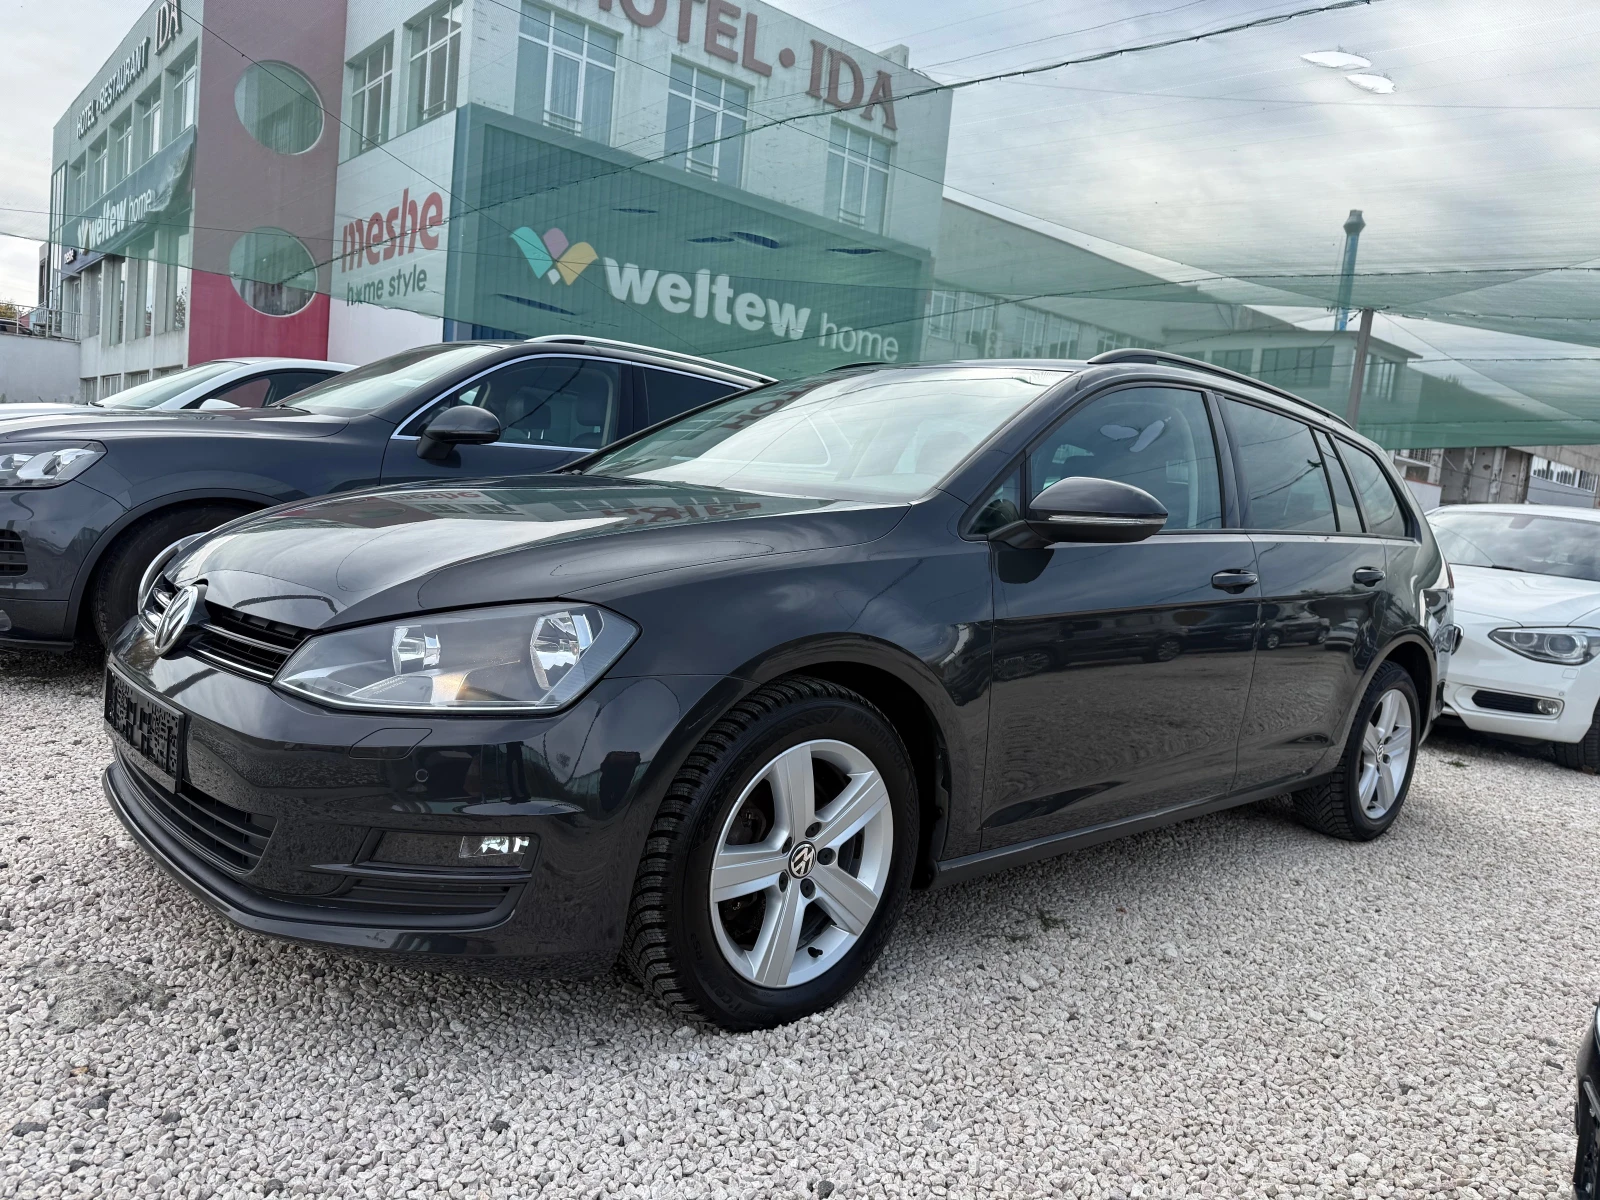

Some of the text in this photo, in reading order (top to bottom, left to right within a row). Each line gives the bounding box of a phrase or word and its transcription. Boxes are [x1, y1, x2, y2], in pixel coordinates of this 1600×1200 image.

[100, 37, 149, 114] RESTAURANT
[154, 0, 182, 55] IDA
[598, 0, 897, 131] OTEL IDA
[88, 189, 152, 249] weltew home
[341, 187, 443, 273] meshe
[388, 264, 427, 296] style
[602, 256, 899, 361] weltew home
